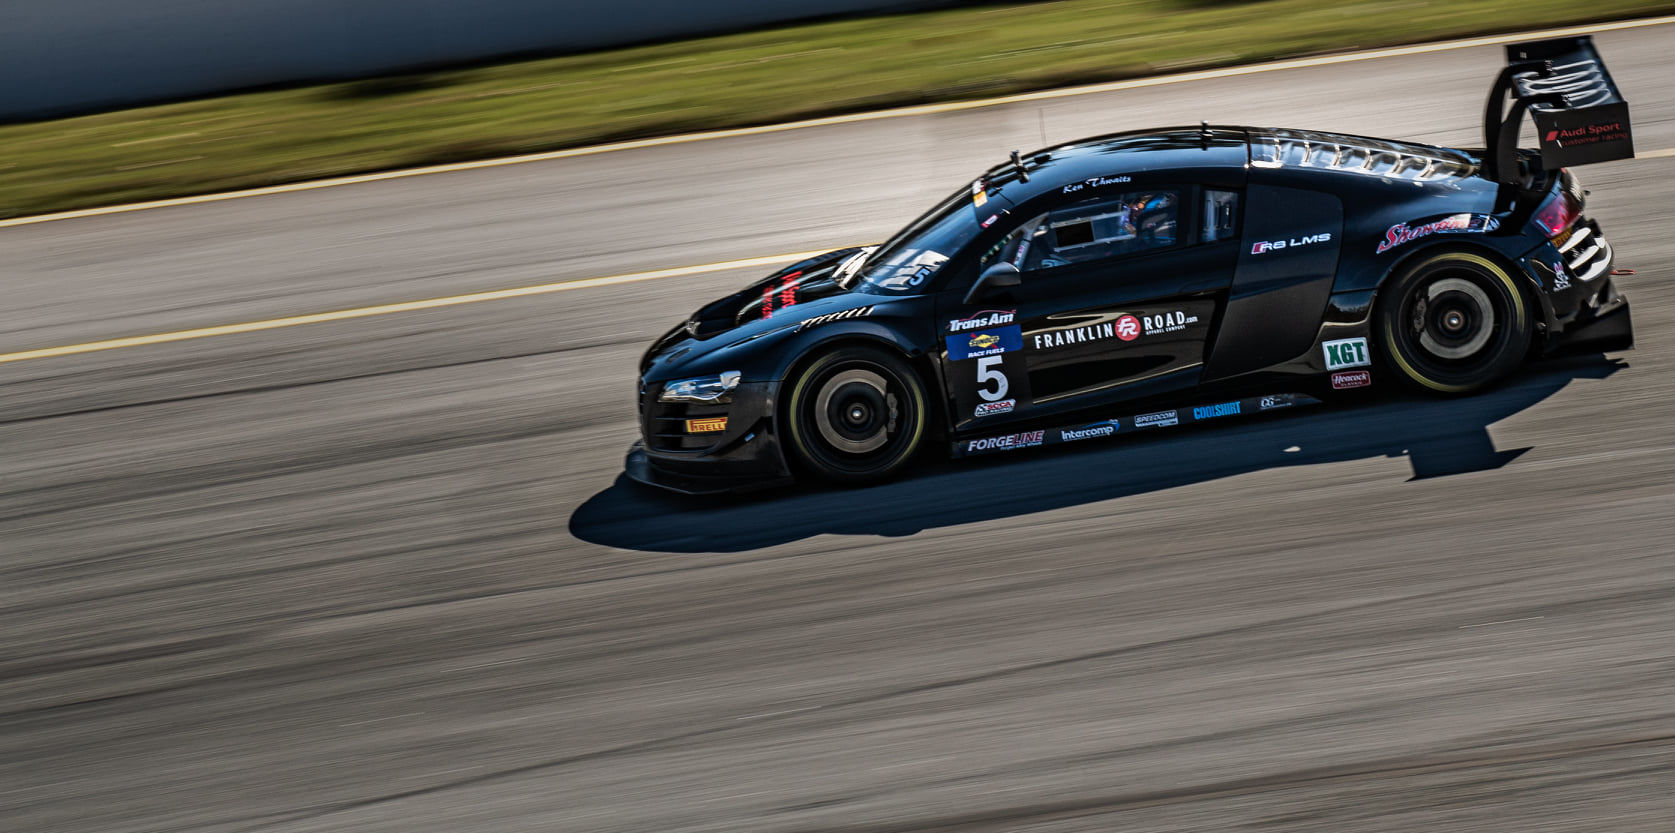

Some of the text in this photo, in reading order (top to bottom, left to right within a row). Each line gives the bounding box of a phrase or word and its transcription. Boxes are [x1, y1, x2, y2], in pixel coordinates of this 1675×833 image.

[1560, 122, 1620, 137] Audi Sport
[1063, 184, 1083, 193] Ken
[1259, 233, 1332, 252] R8 LMS
[949, 313, 1014, 331] Trans Am
[1034, 323, 1114, 349] FRANKLIN
[986, 347, 1005, 355] FUELS
[1327, 342, 1365, 366] XGT
[977, 354, 1009, 401] 5
[1193, 401, 1241, 419] COOLSHIRT
[967, 430, 1045, 451] FORGELINE
[1061, 426, 1114, 440] Intercomp
